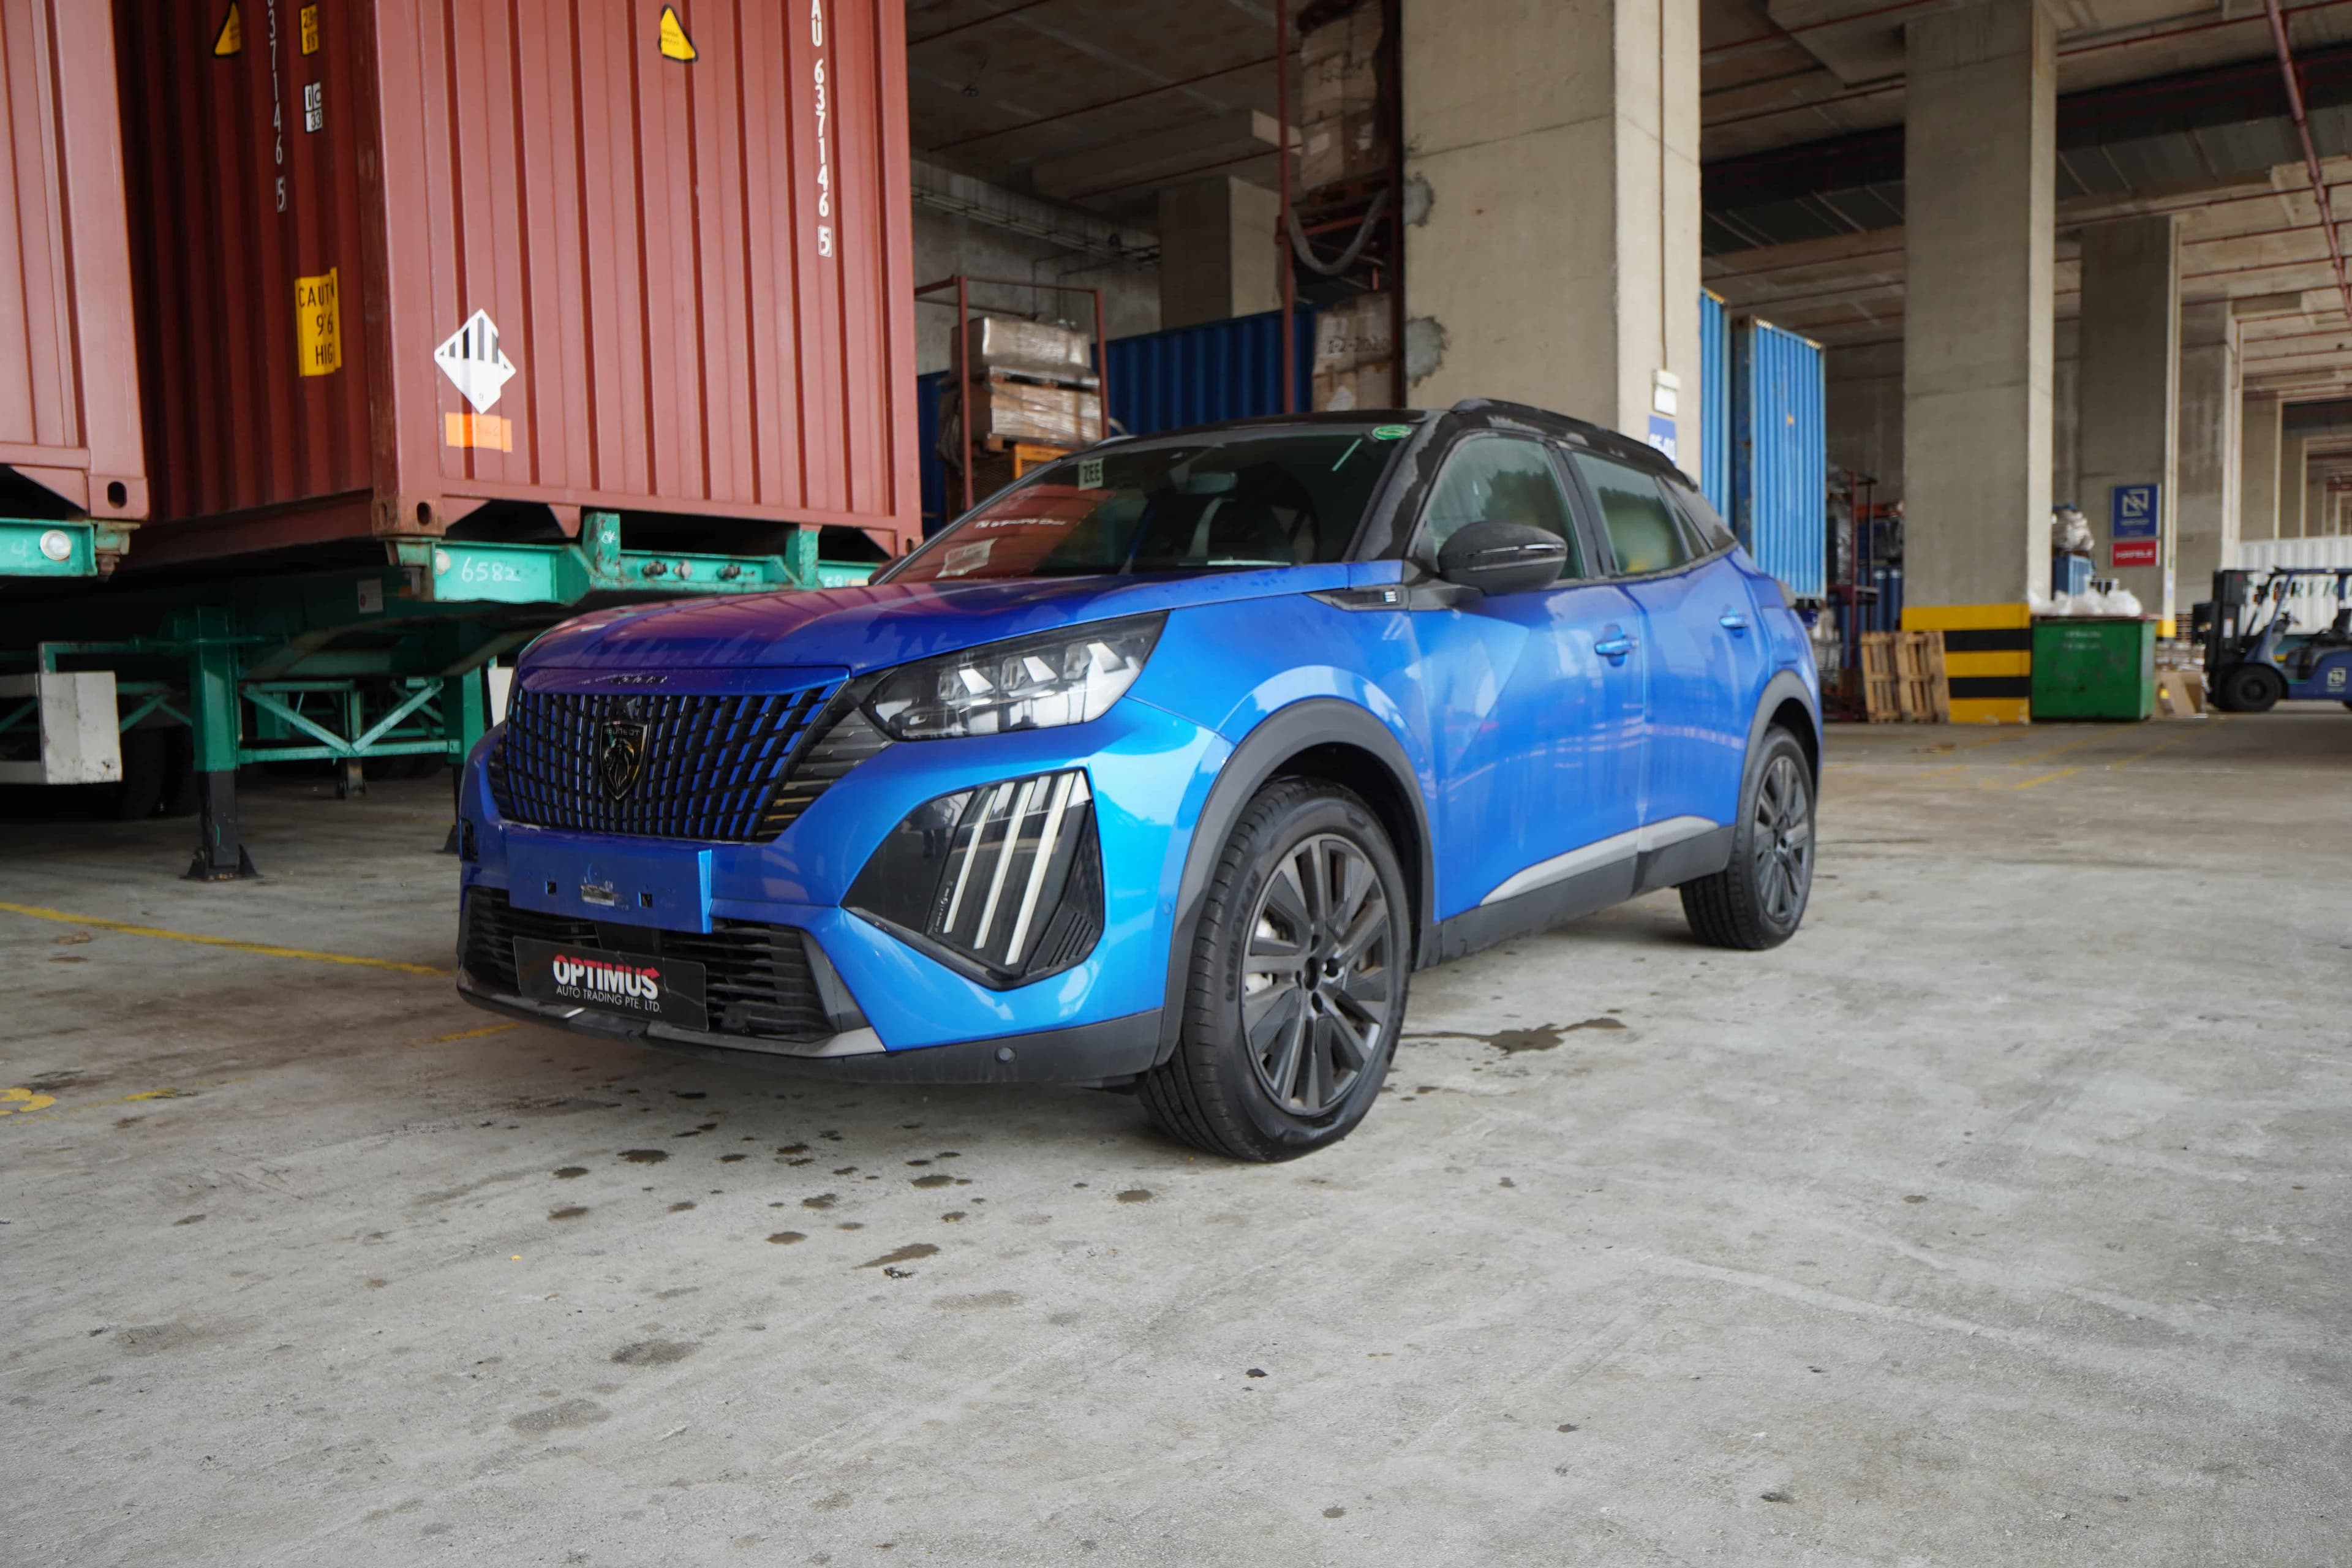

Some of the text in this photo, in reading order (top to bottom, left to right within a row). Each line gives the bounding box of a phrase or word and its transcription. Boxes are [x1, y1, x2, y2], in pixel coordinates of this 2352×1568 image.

[268, 0, 282, 165] 37146
[311, 111, 322, 129] 33
[813, 58, 828, 217] 637146
[818, 225, 832, 257] 5
[315, 343, 333, 366] HIG
[461, 556, 521, 583] 6582
[553, 954, 660, 1000] OPTIMUS
[556, 985, 662, 1014] AUTO TRADING PTE. LTD.
